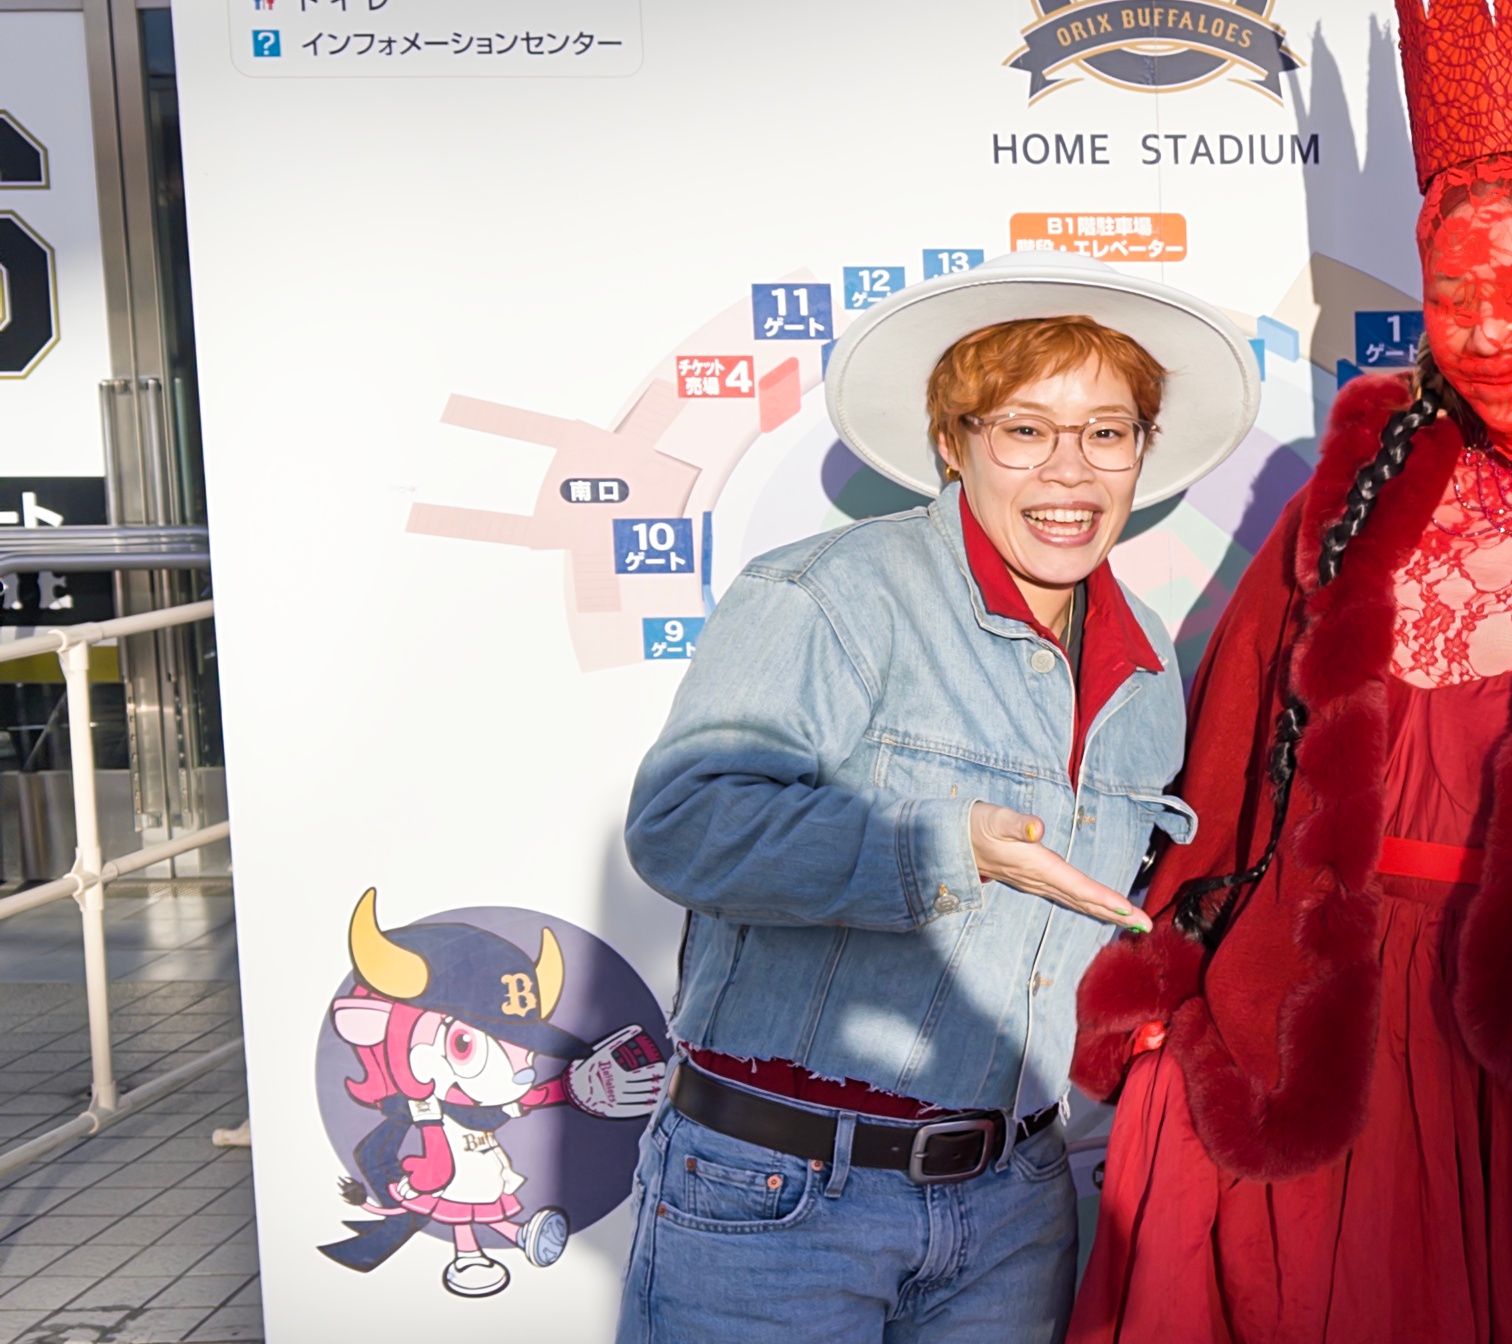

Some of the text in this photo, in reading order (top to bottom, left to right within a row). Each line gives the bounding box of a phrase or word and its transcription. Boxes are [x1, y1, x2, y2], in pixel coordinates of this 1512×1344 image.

[1057, 7, 1253, 50] ORIX BUFFALOES
[302, 31, 623, 58] インフォメーションセンター
[993, 133, 1321, 165] HOME STADIUM
[937, 252, 970, 273] 13
[858, 269, 890, 292] 12
[771, 288, 810, 316] 11
[852, 292, 894, 308] ゲー
[763, 317, 825, 337] ゲート
[1387, 314, 1401, 343] 1
[678, 358, 725, 376] チケット
[725, 360, 753, 394] 4
[685, 377, 720, 396] 売場
[632, 522, 675, 551] 10
[625, 552, 686, 571] ゲート
[664, 620, 684, 642] 9
[500, 973, 537, 1017] B
